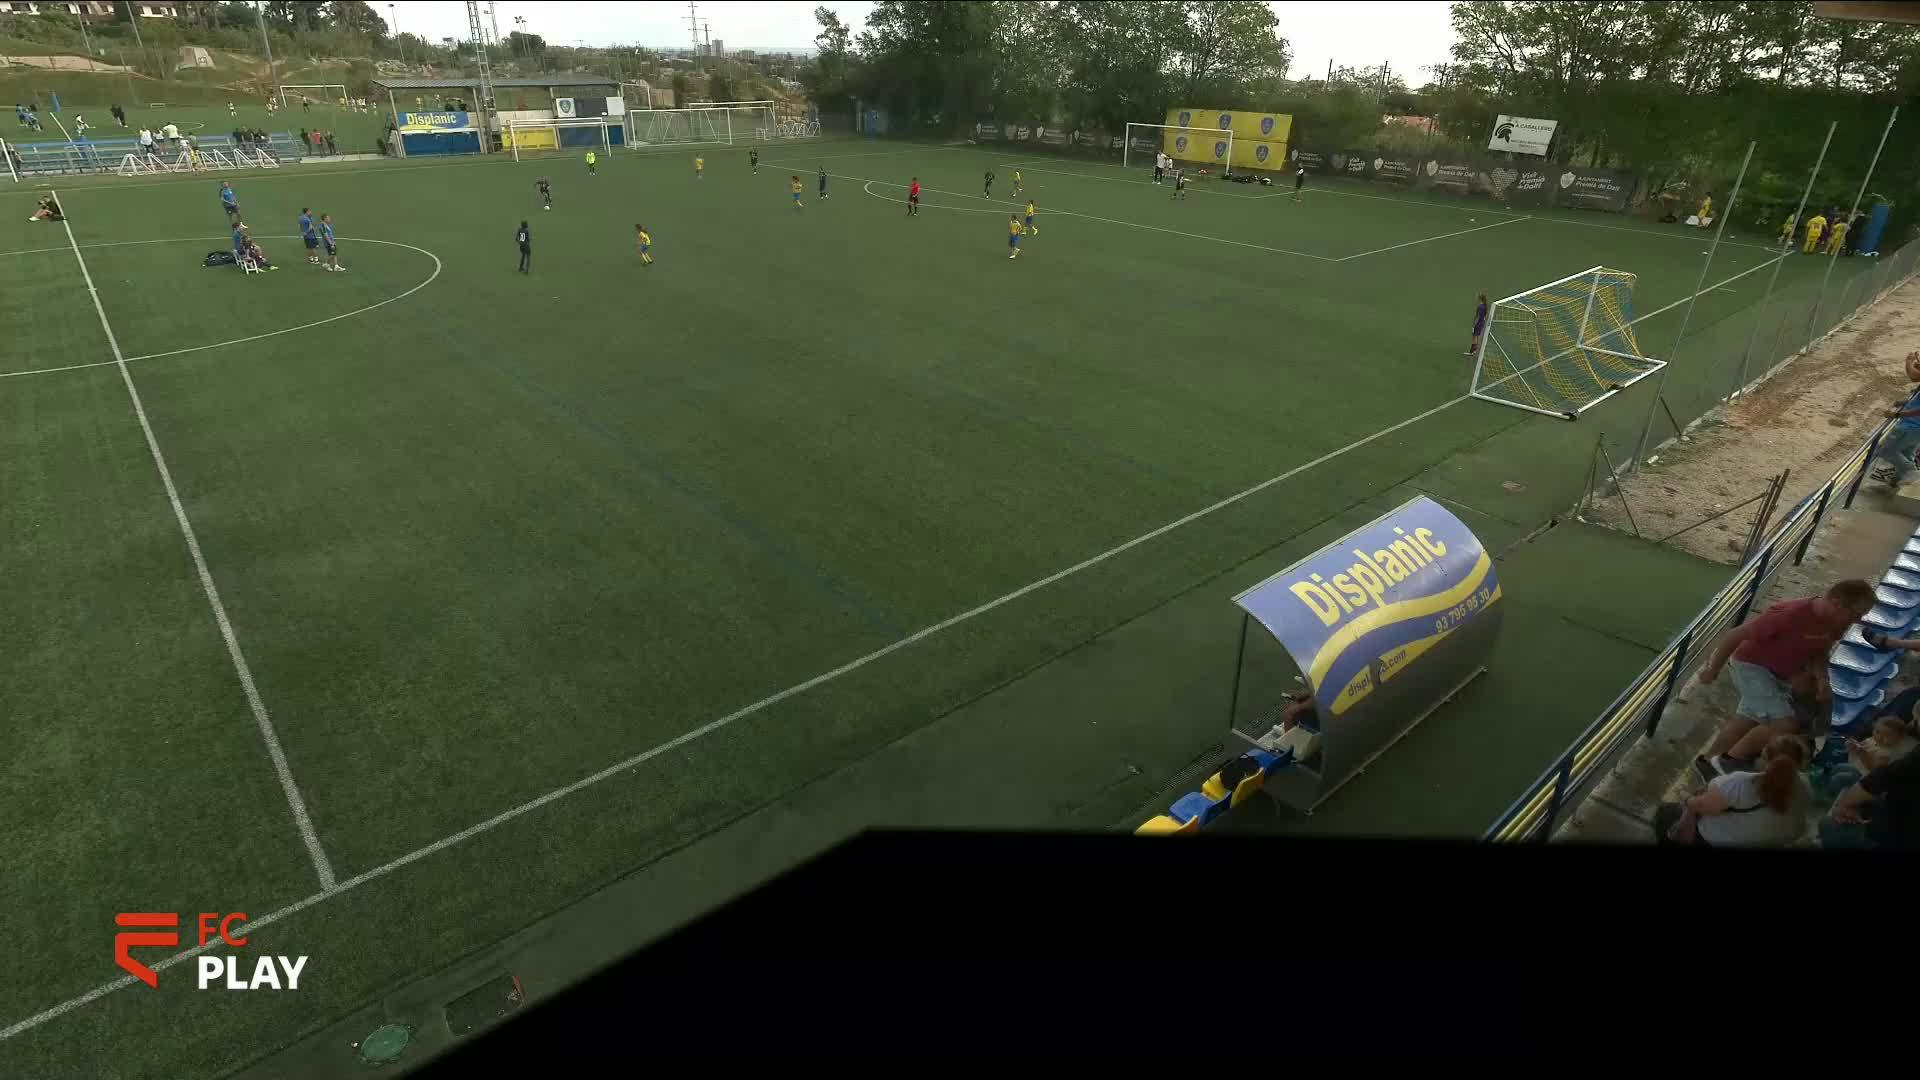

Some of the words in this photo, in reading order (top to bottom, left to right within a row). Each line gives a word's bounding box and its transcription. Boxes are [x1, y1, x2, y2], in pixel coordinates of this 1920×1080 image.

[406, 112, 457, 126] Displanic
[1288, 526, 1447, 627] Displanic
[1435, 615, 1449, 633] 93
